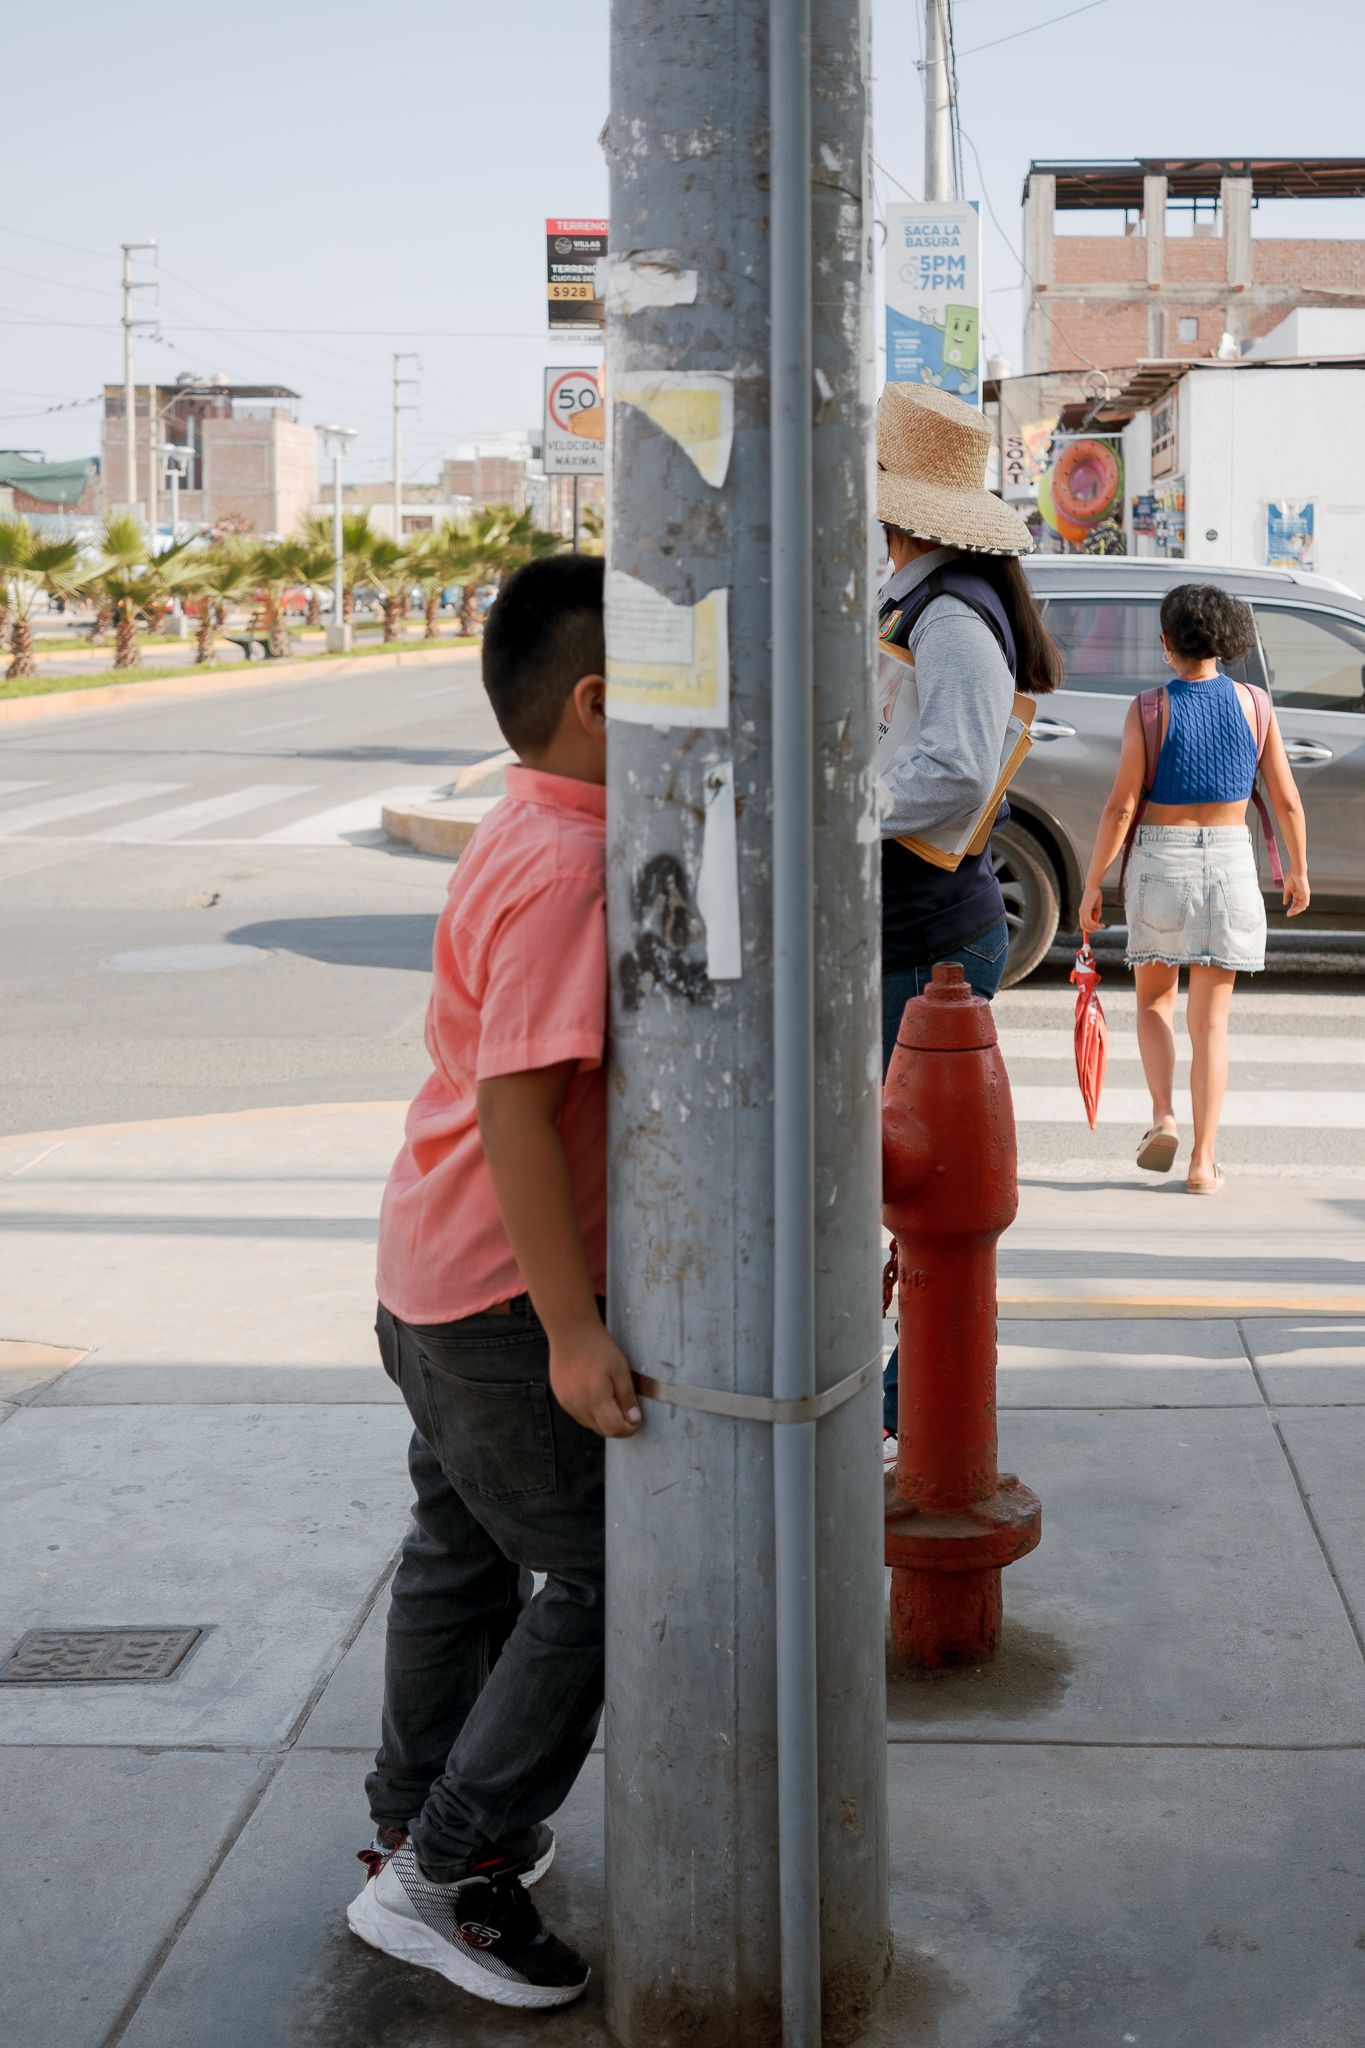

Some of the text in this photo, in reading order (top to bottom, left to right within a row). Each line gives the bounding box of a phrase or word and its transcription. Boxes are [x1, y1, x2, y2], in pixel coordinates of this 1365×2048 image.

[904, 225, 961, 236] SACA LA
[572, 240, 601, 248] VILLAS
[905, 237, 960, 248] BASURA
[920, 255, 965, 272] 5PM
[920, 274, 965, 291] 7PM
[553, 286, 587, 297] $928
[559, 389, 596, 409] 50
[1006, 436, 1023, 485] SOAT
